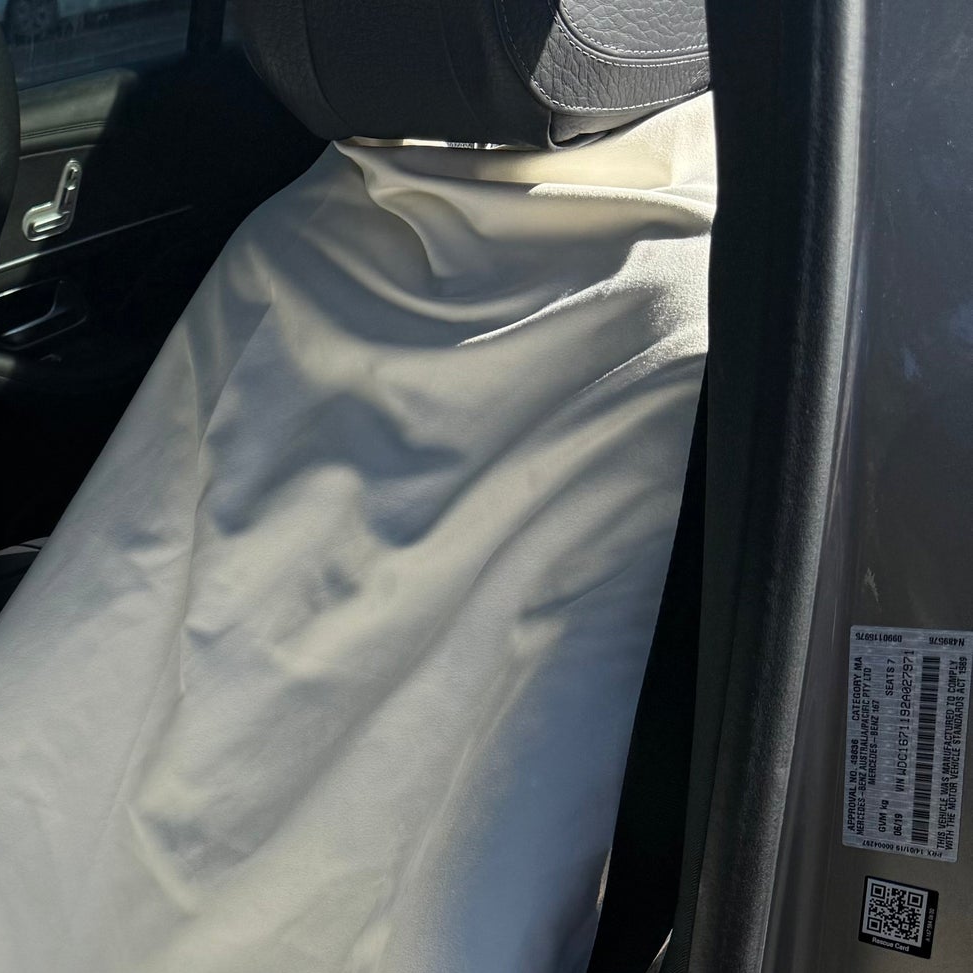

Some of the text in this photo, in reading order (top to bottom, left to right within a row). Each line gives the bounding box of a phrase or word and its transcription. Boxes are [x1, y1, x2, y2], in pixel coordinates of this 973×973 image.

[852, 657, 862, 721] CATEGORY MA
[863, 684, 871, 697] PTY
[885, 667, 895, 696] SEATS
[957, 678, 966, 693] ACT
[859, 701, 869, 771] AUSTRALIA/PACIFIC
[895, 650, 914, 792] VIN WDC1671192A027971
[953, 696, 965, 744] STANDARDS
[868, 716, 879, 785] MERCEDES-BENZ
[937, 660, 957, 849] THIS VEHICLE WAS MANUFACTURED TO COMPLY
[950, 747, 960, 779] VEHICLE
[848, 786, 856, 831] APPROVAL
[857, 773, 866, 835] MERCEDES-BENZ
[948, 783, 958, 810] MOTOR
[878, 800, 888, 832] GVM kg
[894, 813, 902, 836] 06/19
[947, 813, 955, 827] THE
[945, 830, 954, 850] WITH
[872, 937, 909, 952] Rescue Card
